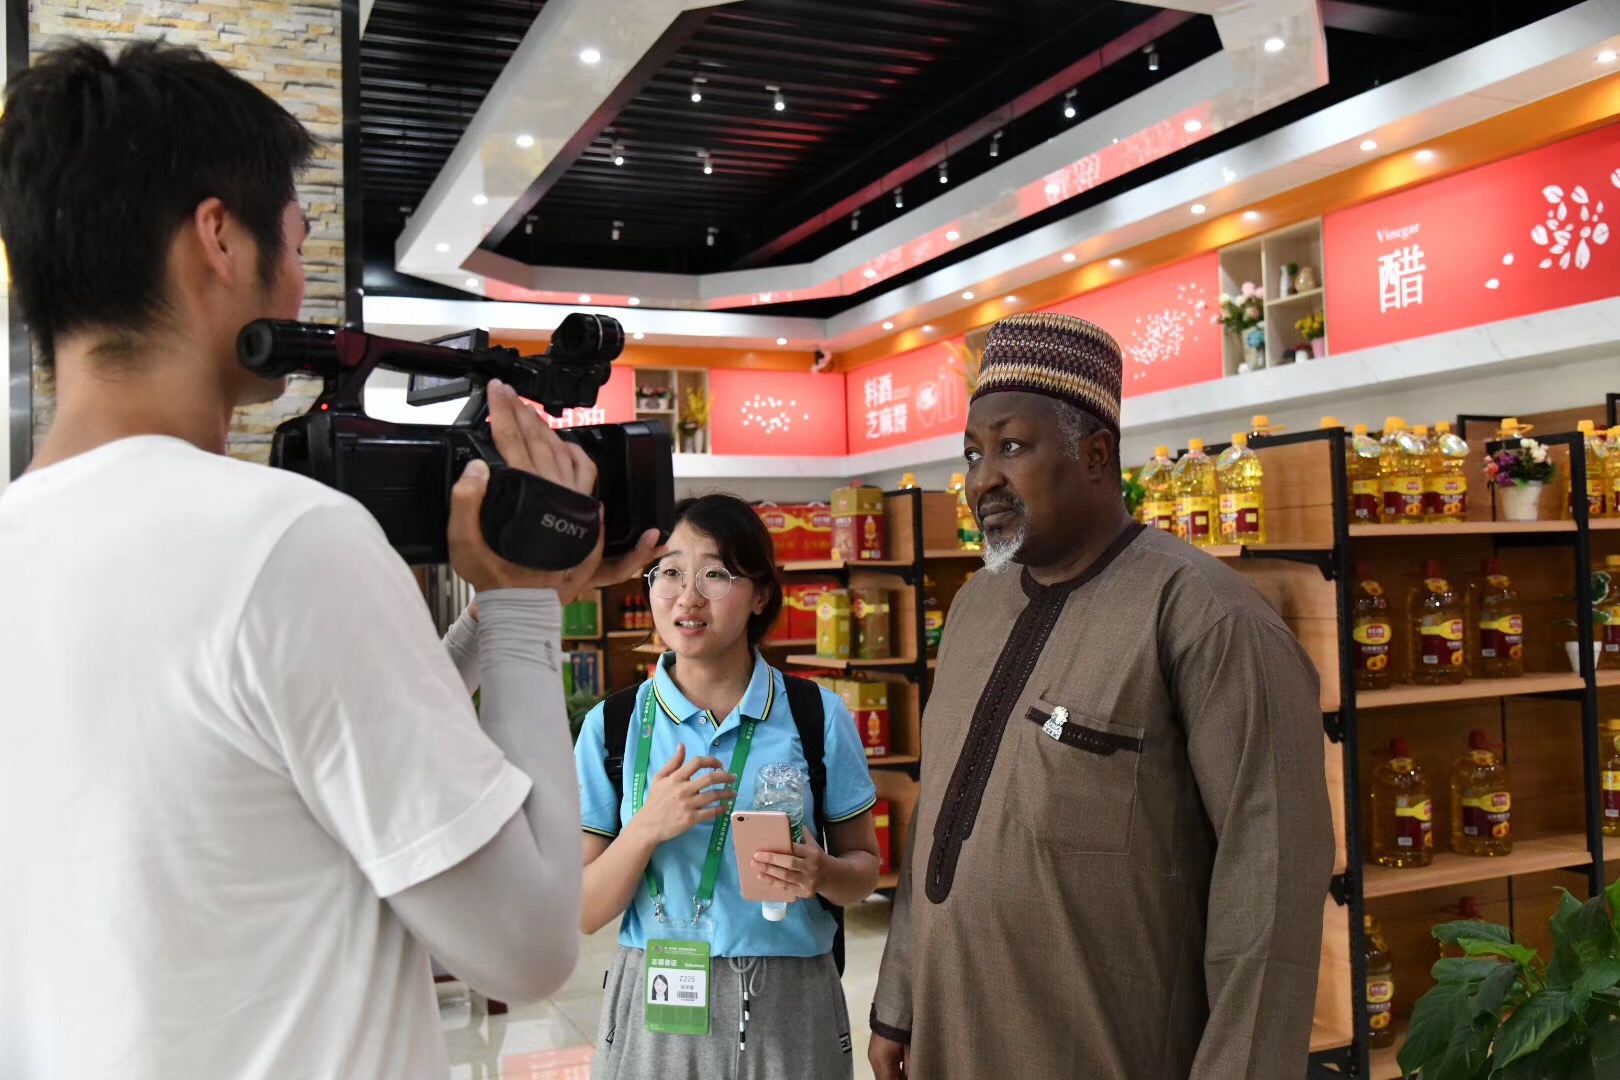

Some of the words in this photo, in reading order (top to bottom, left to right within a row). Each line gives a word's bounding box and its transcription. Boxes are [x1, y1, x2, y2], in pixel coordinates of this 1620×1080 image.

[1376, 223, 1421, 242] Vinegar
[1378, 244, 1427, 314] 醋
[864, 373, 893, 409] 料酒
[541, 513, 588, 539] SONY
